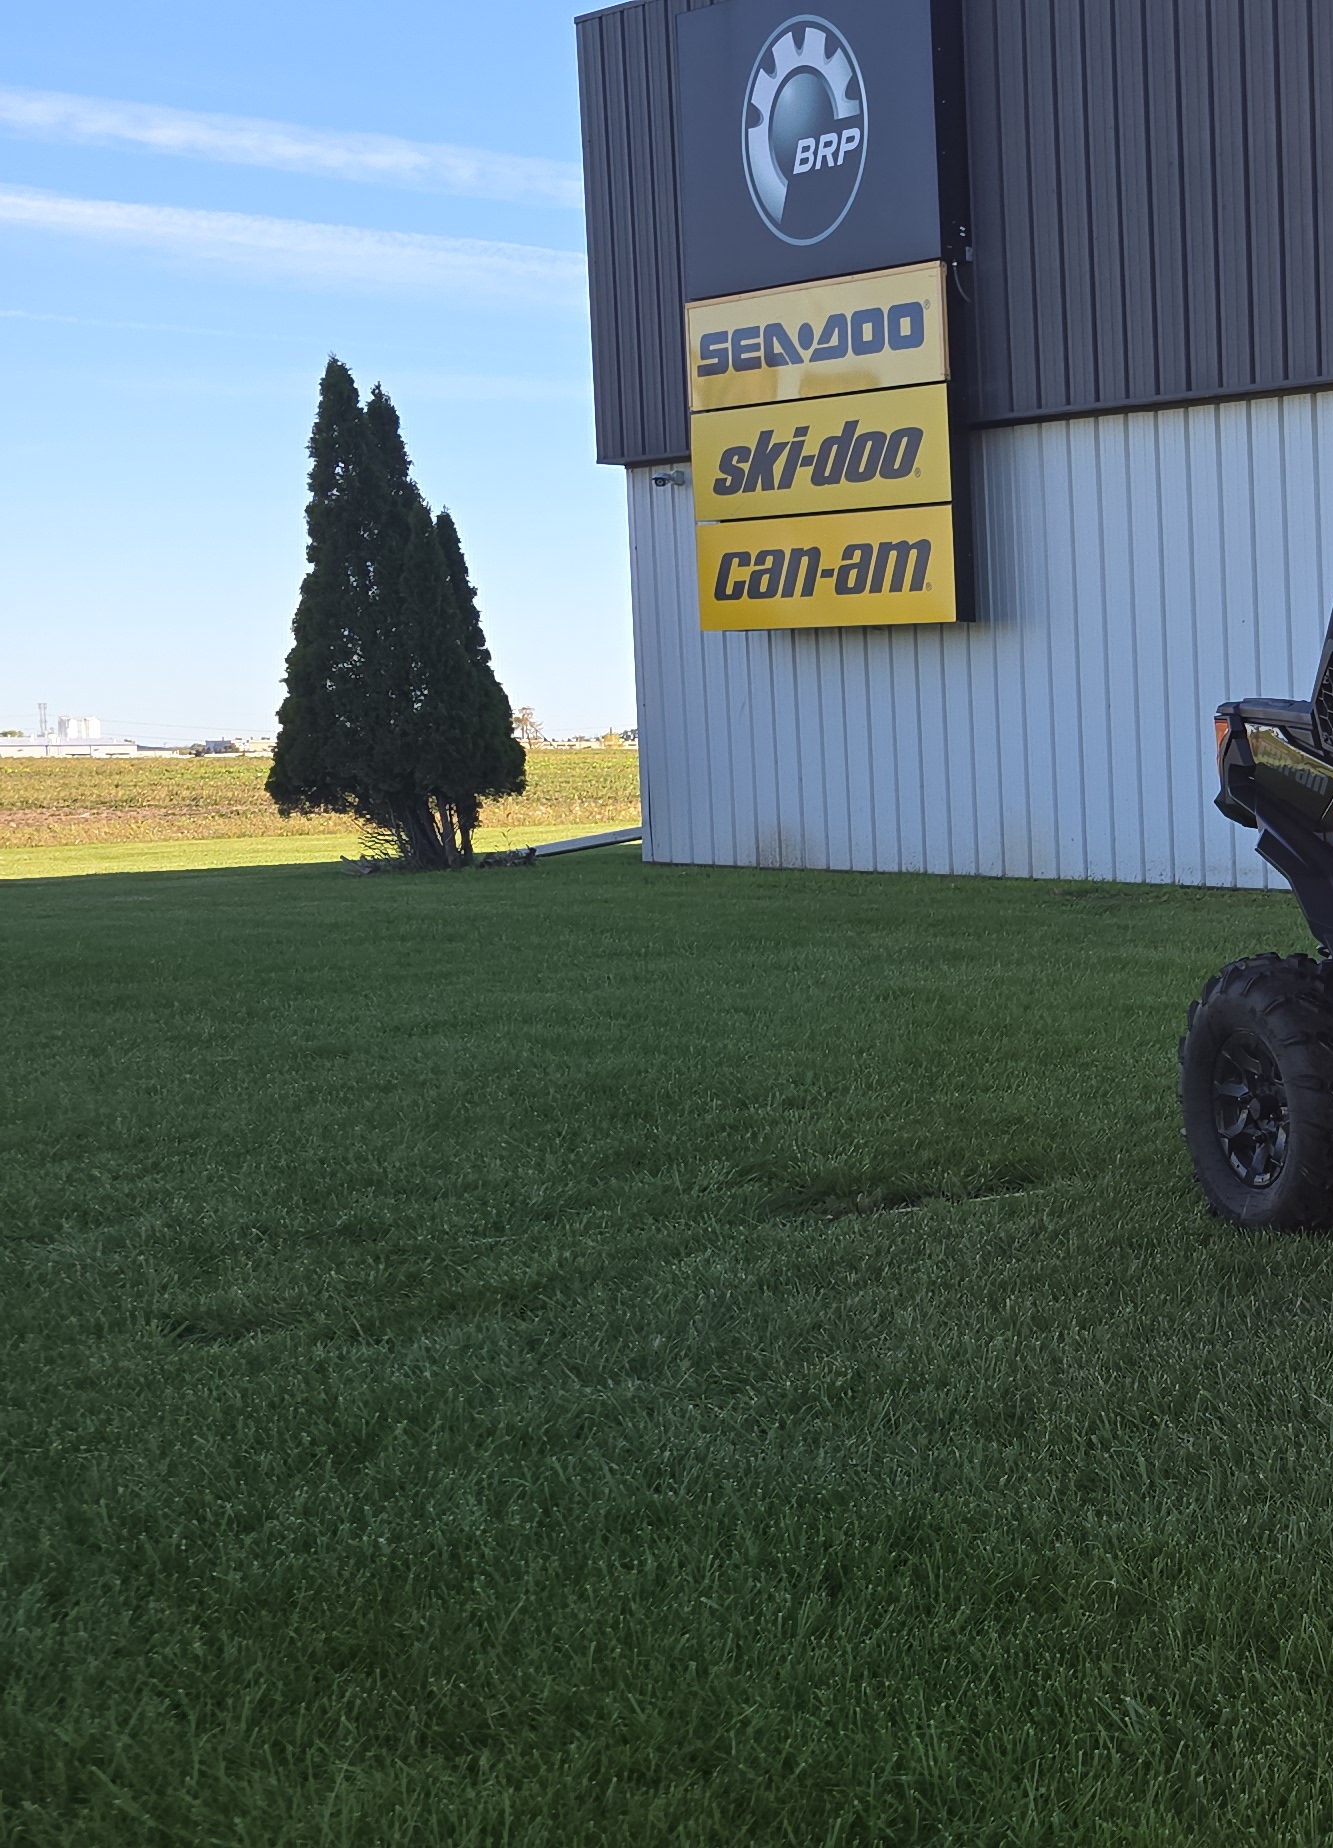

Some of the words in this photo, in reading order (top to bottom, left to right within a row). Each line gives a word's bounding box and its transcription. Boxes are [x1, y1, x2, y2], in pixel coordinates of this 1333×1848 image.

[793, 127, 862, 176] BRP
[712, 420, 924, 497] ski-doo
[713, 537, 933, 602] can-am
